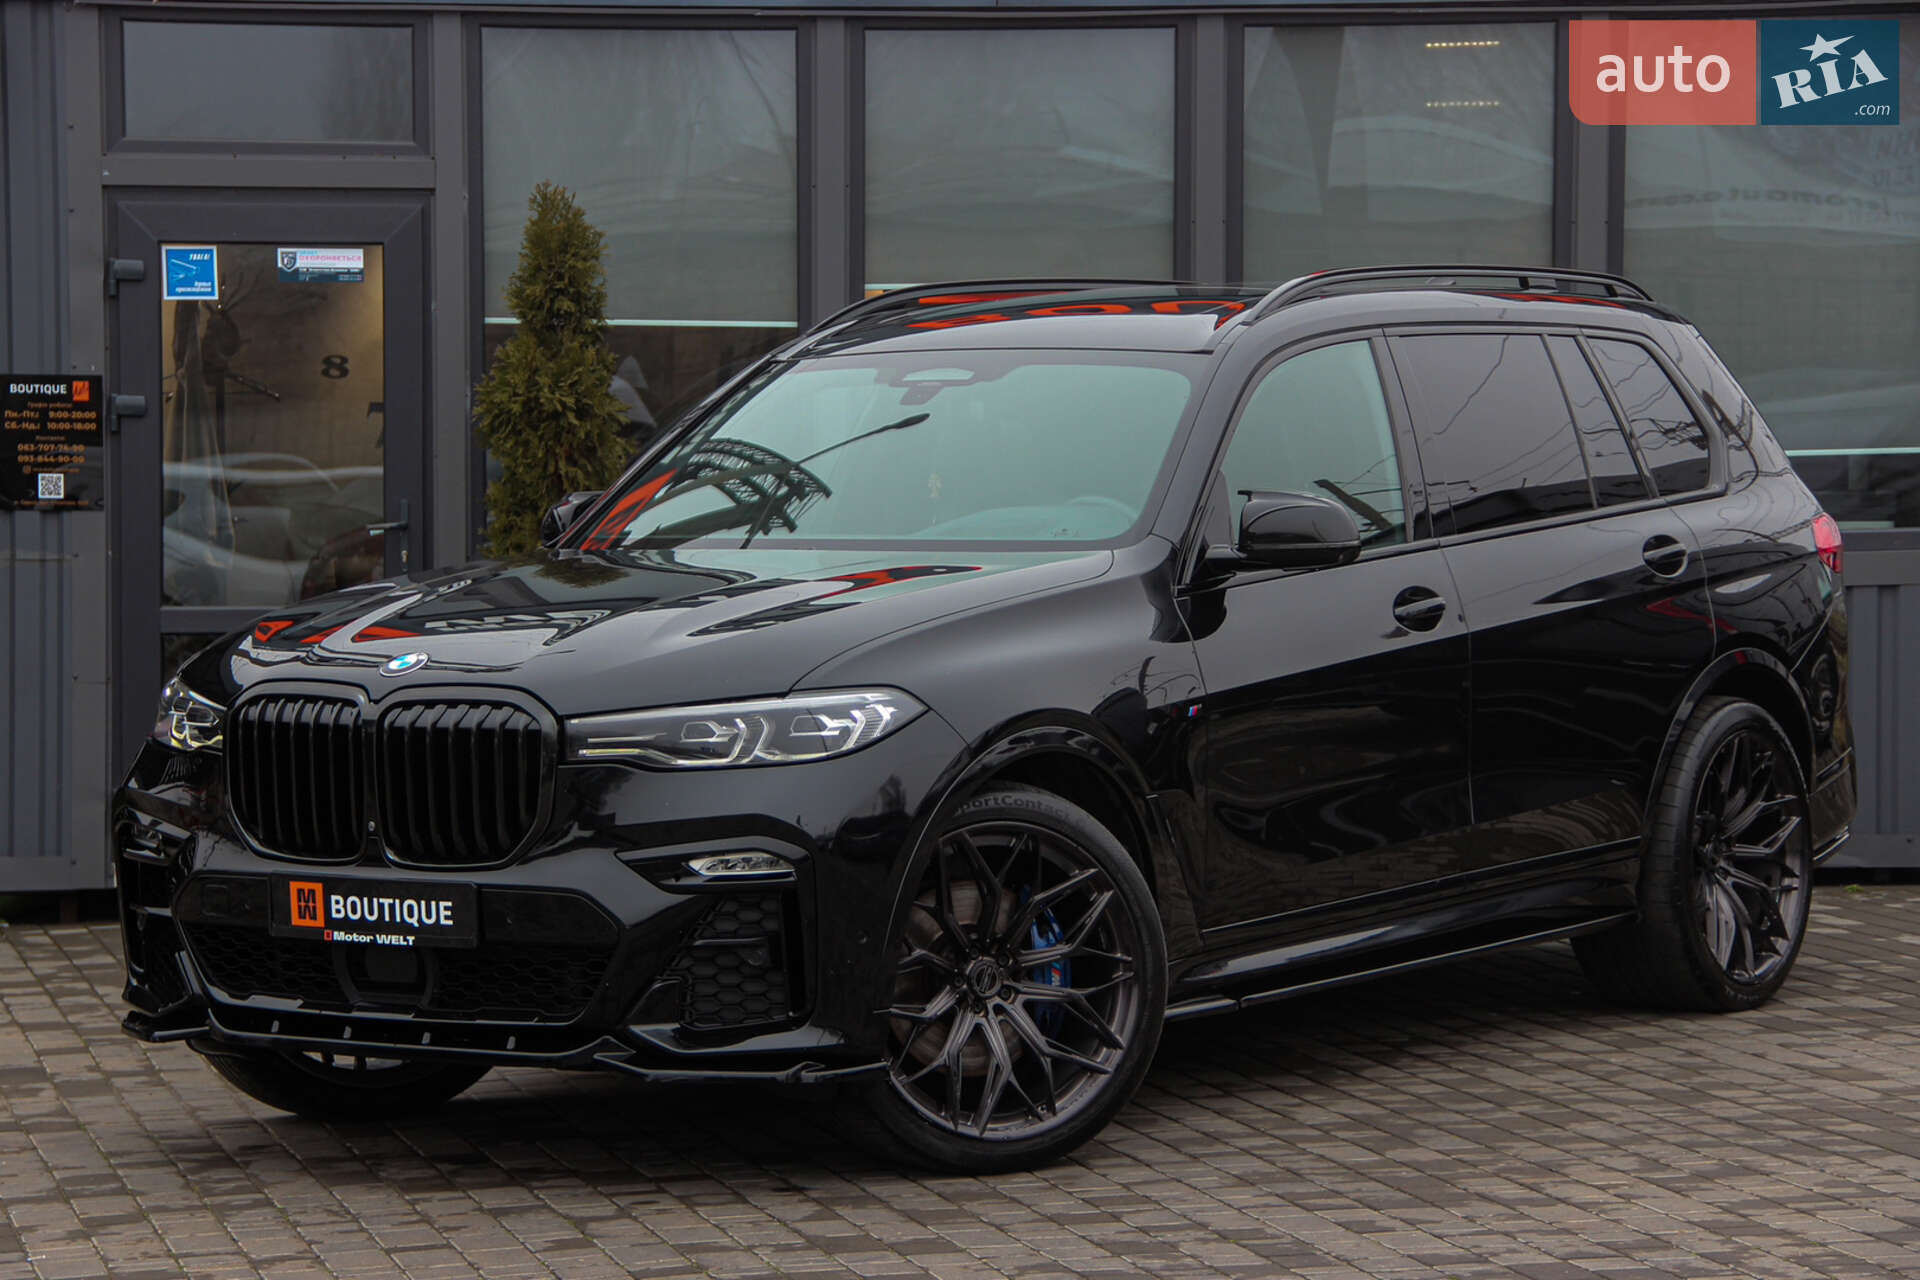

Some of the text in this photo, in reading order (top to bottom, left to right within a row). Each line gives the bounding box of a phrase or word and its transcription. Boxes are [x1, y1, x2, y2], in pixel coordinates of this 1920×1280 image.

[9, 383, 67, 395] BOUTIQUE
[330, 894, 453, 927] BOUTIQUE
[333, 931, 416, 946] Motor WELT
